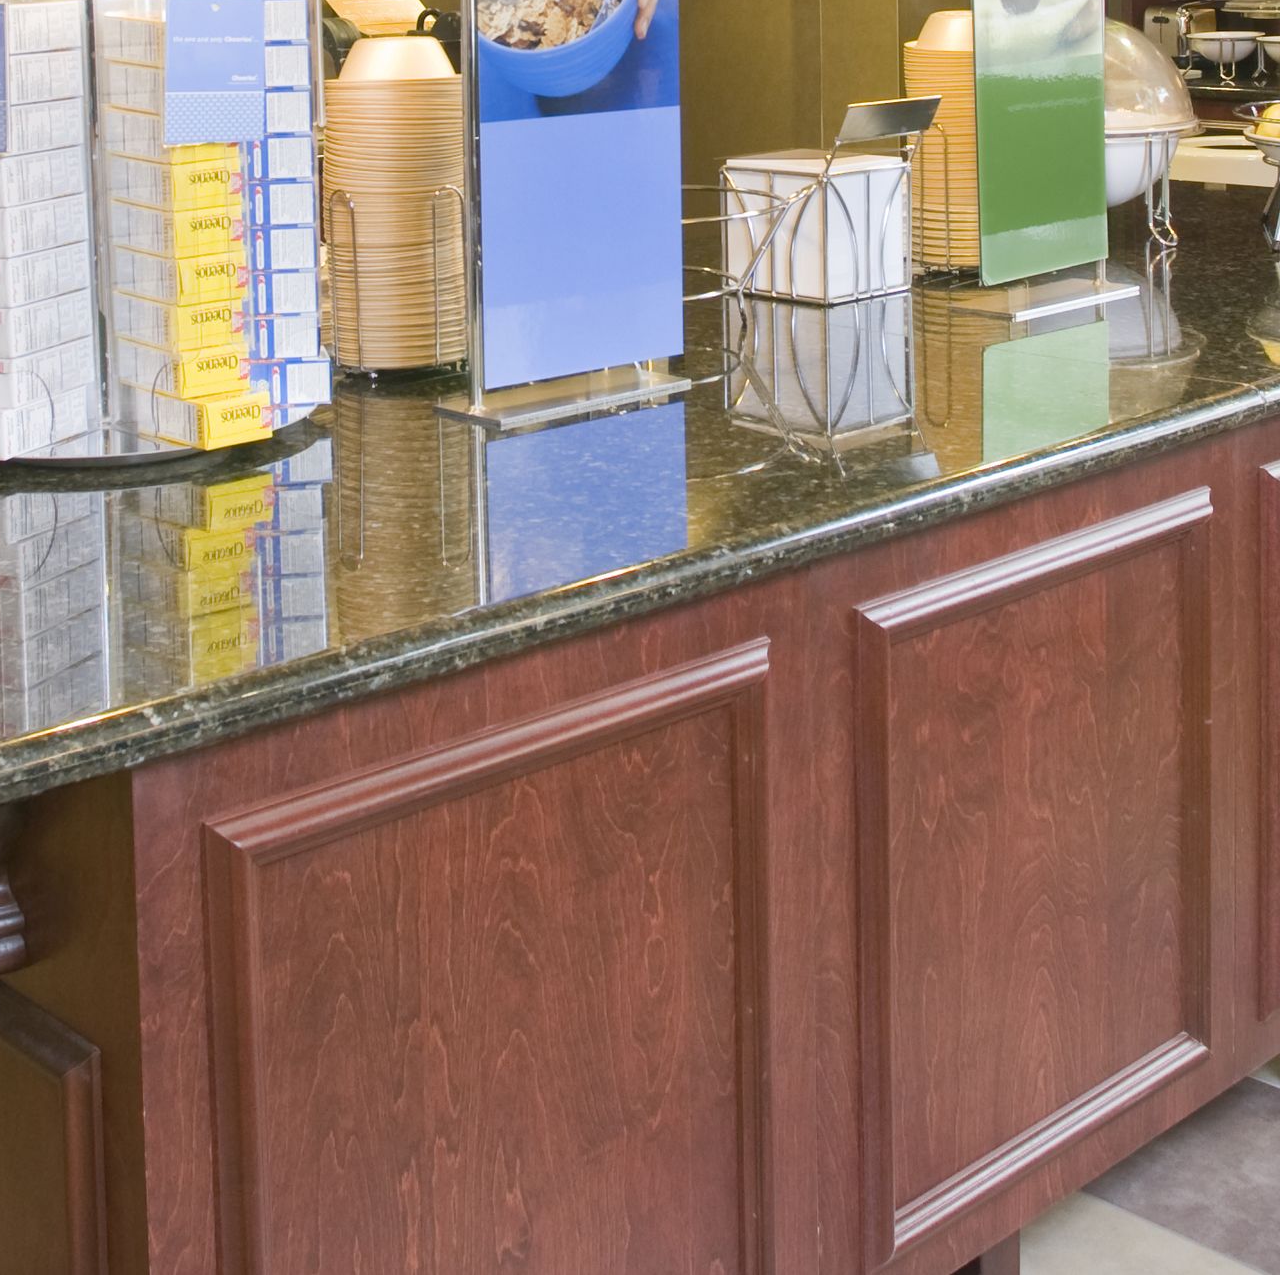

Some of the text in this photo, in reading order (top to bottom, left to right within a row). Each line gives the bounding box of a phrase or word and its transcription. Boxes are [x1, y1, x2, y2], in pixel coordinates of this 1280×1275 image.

[189, 170, 231, 185] Cheerios
[190, 215, 232, 231] Cheerios
[195, 262, 237, 279] Cheerios
[191, 308, 232, 325] Cheerios
[197, 355, 238, 373] Cheerios
[221, 405, 261, 422] Cheerios
